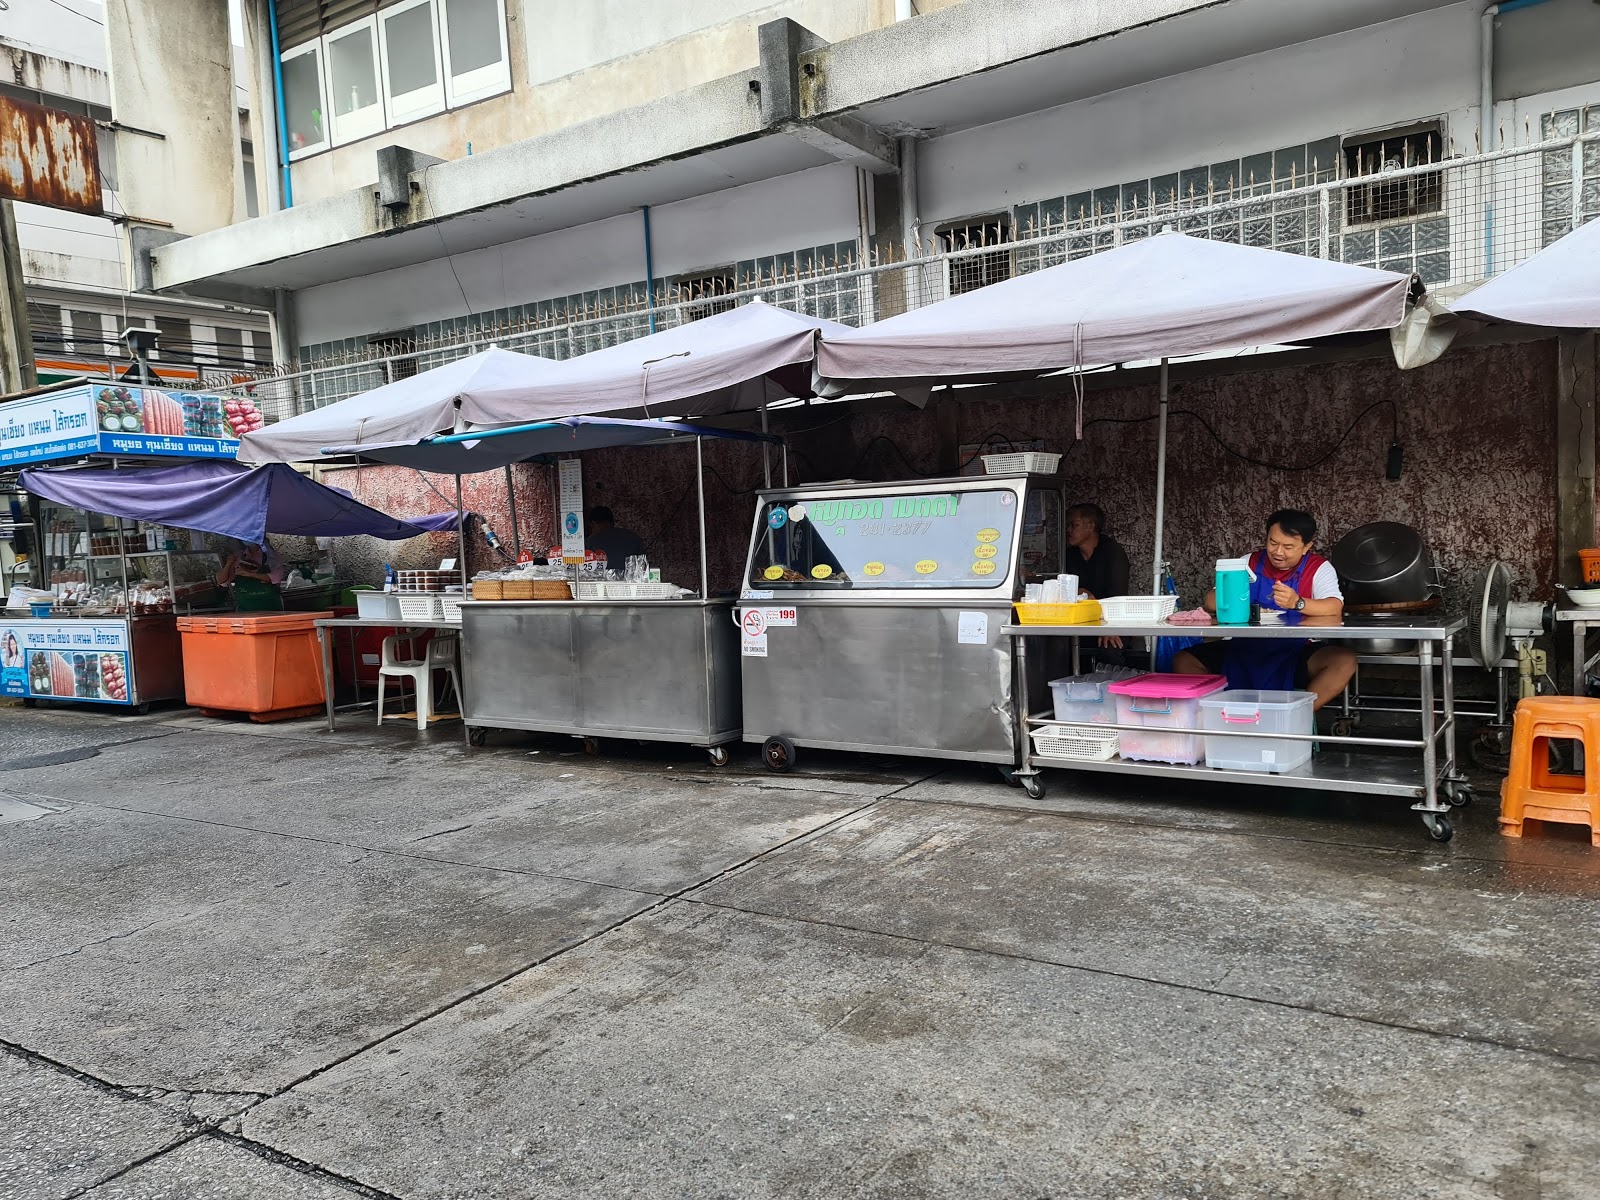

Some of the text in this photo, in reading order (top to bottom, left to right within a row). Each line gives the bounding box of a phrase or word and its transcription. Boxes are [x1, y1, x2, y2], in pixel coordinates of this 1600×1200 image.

[28, 419, 52, 436] แหนม
[53, 409, 88, 431] ไส้กรอก
[112, 438, 142, 451] หมูยอ
[146, 437, 184, 452] กุนเชียง
[188, 443, 215, 452] แหนม
[809, 500, 884, 526] หมูทอด
[583, 563, 593, 571] 25
[596, 562, 604, 570] 25
[779, 609, 795, 619] 199
